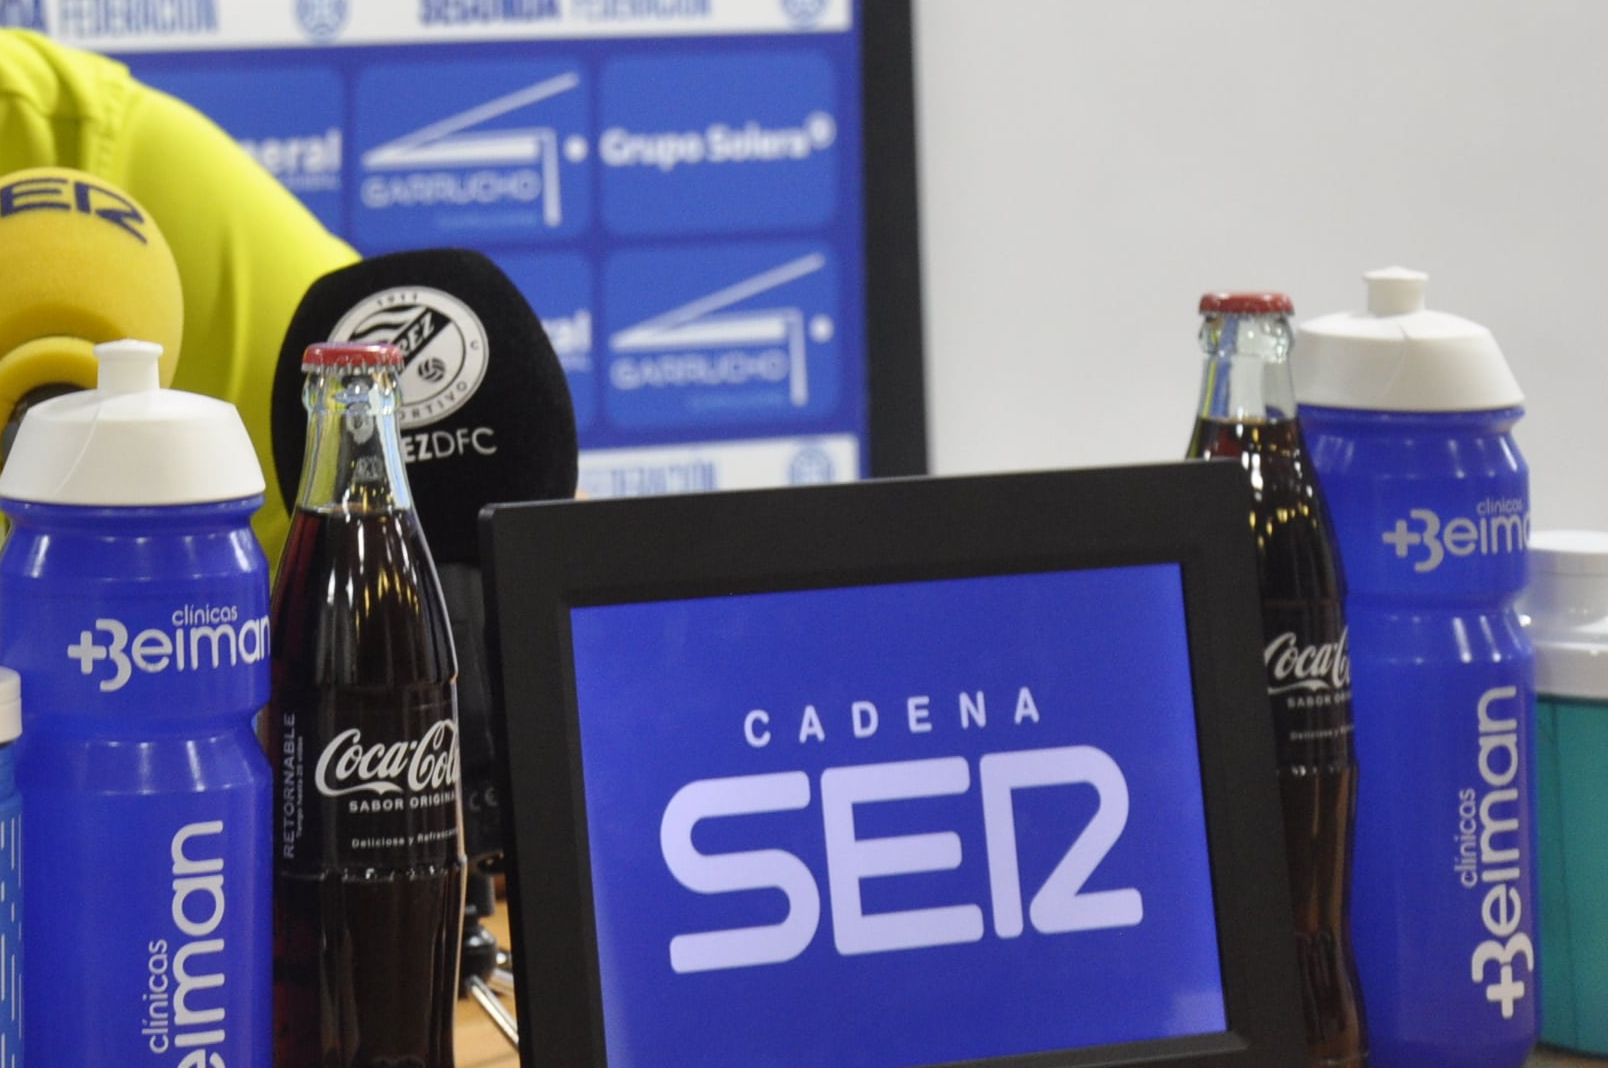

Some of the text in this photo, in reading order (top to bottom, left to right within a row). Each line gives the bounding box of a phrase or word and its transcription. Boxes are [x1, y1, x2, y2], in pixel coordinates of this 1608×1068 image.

[600, 128, 705, 173] Grupo
[172, 603, 237, 627] clínicas
[744, 686, 1040, 748] CADENA
[284, 713, 296, 859] RETORNABLE
[349, 798, 404, 813] SABOR
[659, 744, 1144, 975] SER
[1454, 788, 1478, 888] clínicas
[142, 938, 169, 1054] clínicas
